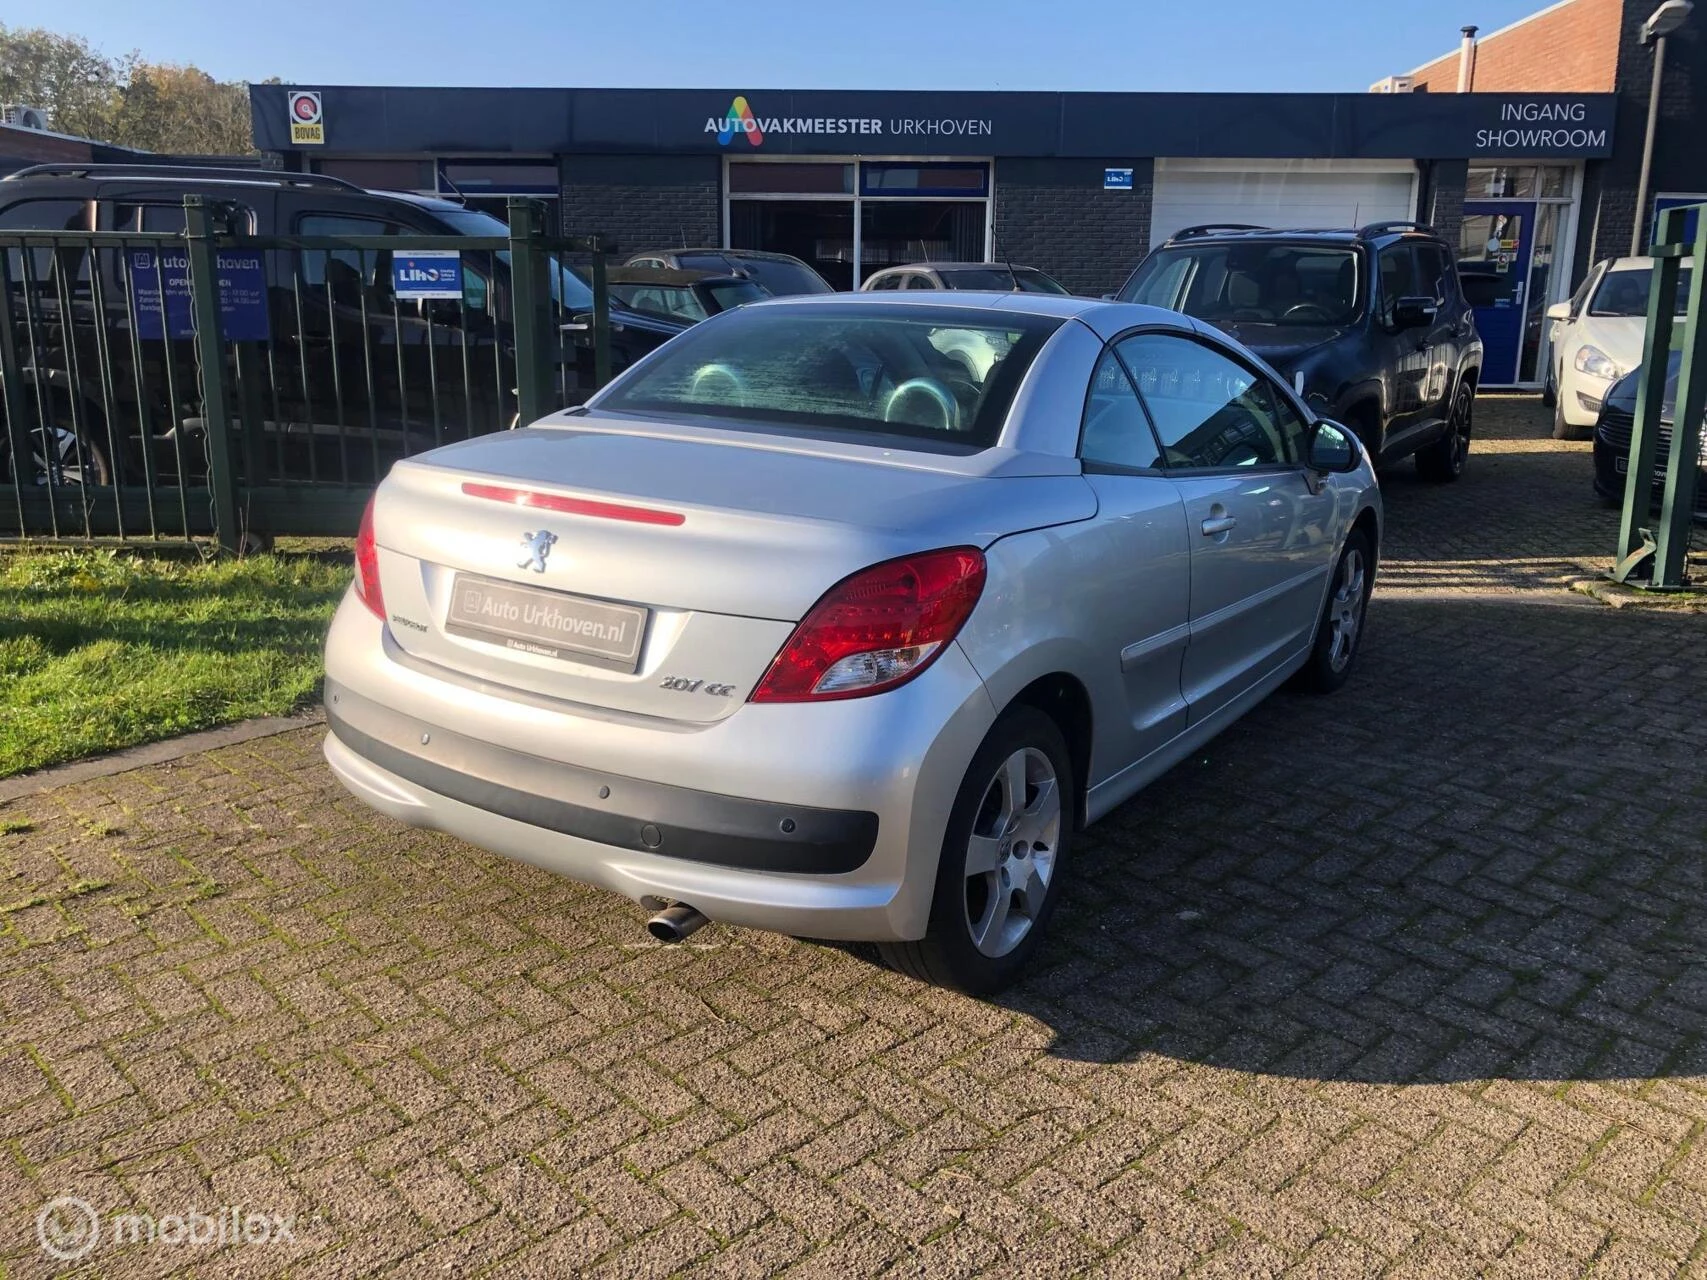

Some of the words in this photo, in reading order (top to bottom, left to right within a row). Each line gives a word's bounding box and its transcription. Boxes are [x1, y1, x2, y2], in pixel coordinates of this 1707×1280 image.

[1501, 103, 1585, 121] INGANG
[294, 126, 321, 140] BOVAG
[704, 117, 882, 134] AUTOVAKMEESTER
[890, 119, 992, 135] URKHOVEN
[1476, 129, 1606, 147] SHOWROOM
[481, 596, 520, 620] Auto
[523, 603, 626, 643] Urkhoven.nl
[512, 641, 526, 650] Auto
[659, 676, 704, 693] 207
